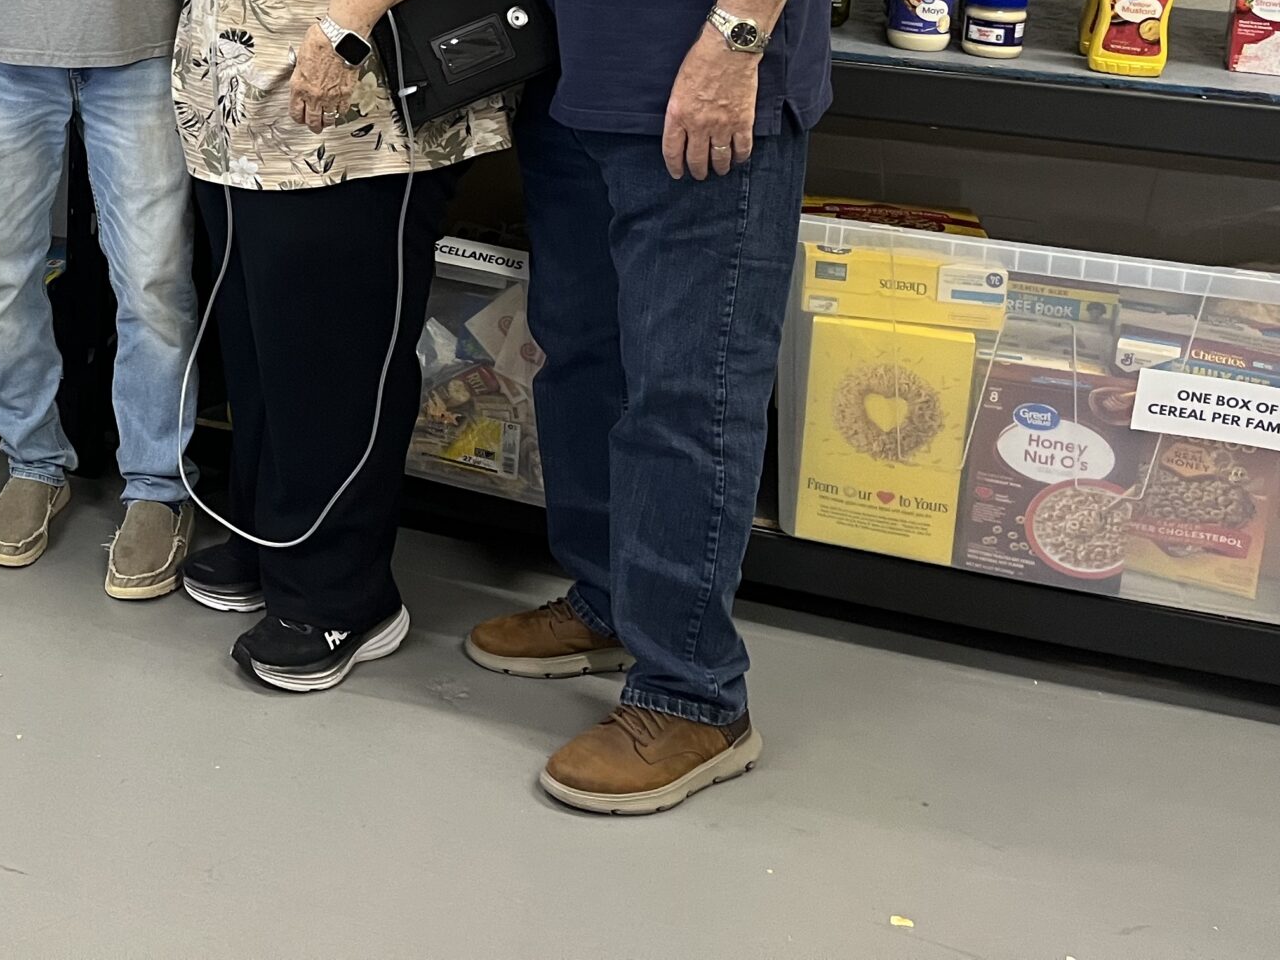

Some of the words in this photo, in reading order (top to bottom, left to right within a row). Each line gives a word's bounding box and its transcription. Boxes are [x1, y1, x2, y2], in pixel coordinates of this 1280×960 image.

[922, 7, 945, 16] Mayo
[1122, 6, 1157, 16] Mustard
[434, 243, 524, 270] SCELLANEOUS
[880, 278, 927, 296] Cheerios
[1007, 299, 1031, 311] REE
[1035, 302, 1073, 318] BOOK
[1191, 348, 1247, 368] Cheerios
[989, 391, 999, 403] 8
[1177, 390, 1213, 405] ONE
[1216, 395, 1252, 411] BOX
[1256, 402, 1279, 415] OF
[1019, 408, 1052, 421] Great
[1027, 416, 1051, 427] Value
[1148, 403, 1207, 422] CEREAL
[1211, 412, 1241, 427] PER
[1245, 417, 1280, 434] FAM
[1028, 433, 1088, 457] Honey
[1024, 449, 1055, 466] Nut
[1061, 456, 1088, 472] O's
[1167, 458, 1211, 473] HONEY
[807, 477, 839, 496] From
[899, 495, 911, 508] to
[914, 497, 949, 513] Yours
[1158, 527, 1243, 548] CHOLESTEROL
